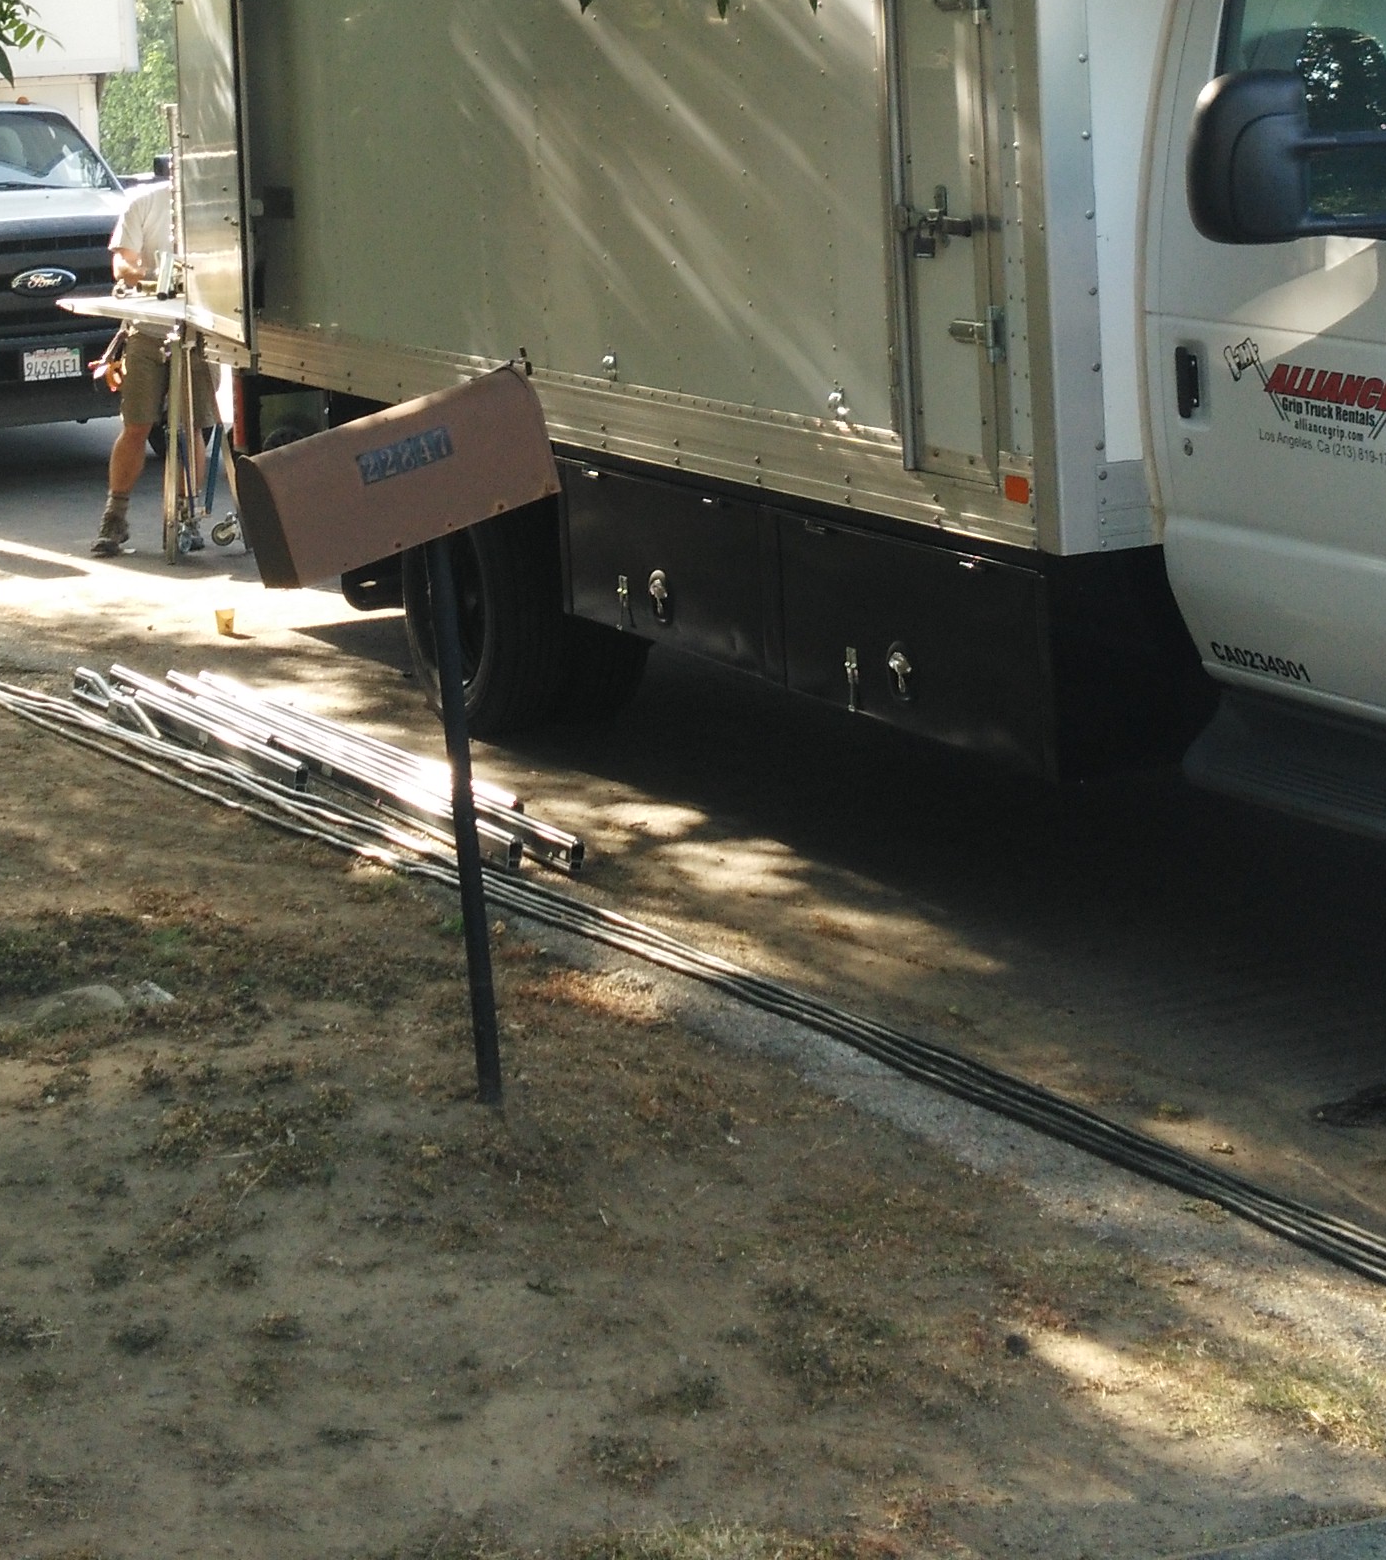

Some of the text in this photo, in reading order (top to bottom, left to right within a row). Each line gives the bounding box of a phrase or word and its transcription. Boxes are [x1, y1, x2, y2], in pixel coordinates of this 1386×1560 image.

[27, 272, 63, 289] Ford
[1282, 396, 1303, 415] Grip
[1305, 400, 1333, 419] Truck
[1294, 418, 1364, 442] alliancegrip.com
[1259, 428, 1275, 441] Los
[1316, 439, 1330, 453] Ca
[1332, 442, 1356, 462] (213)
[1210, 641, 1311, 683] CA0234901
